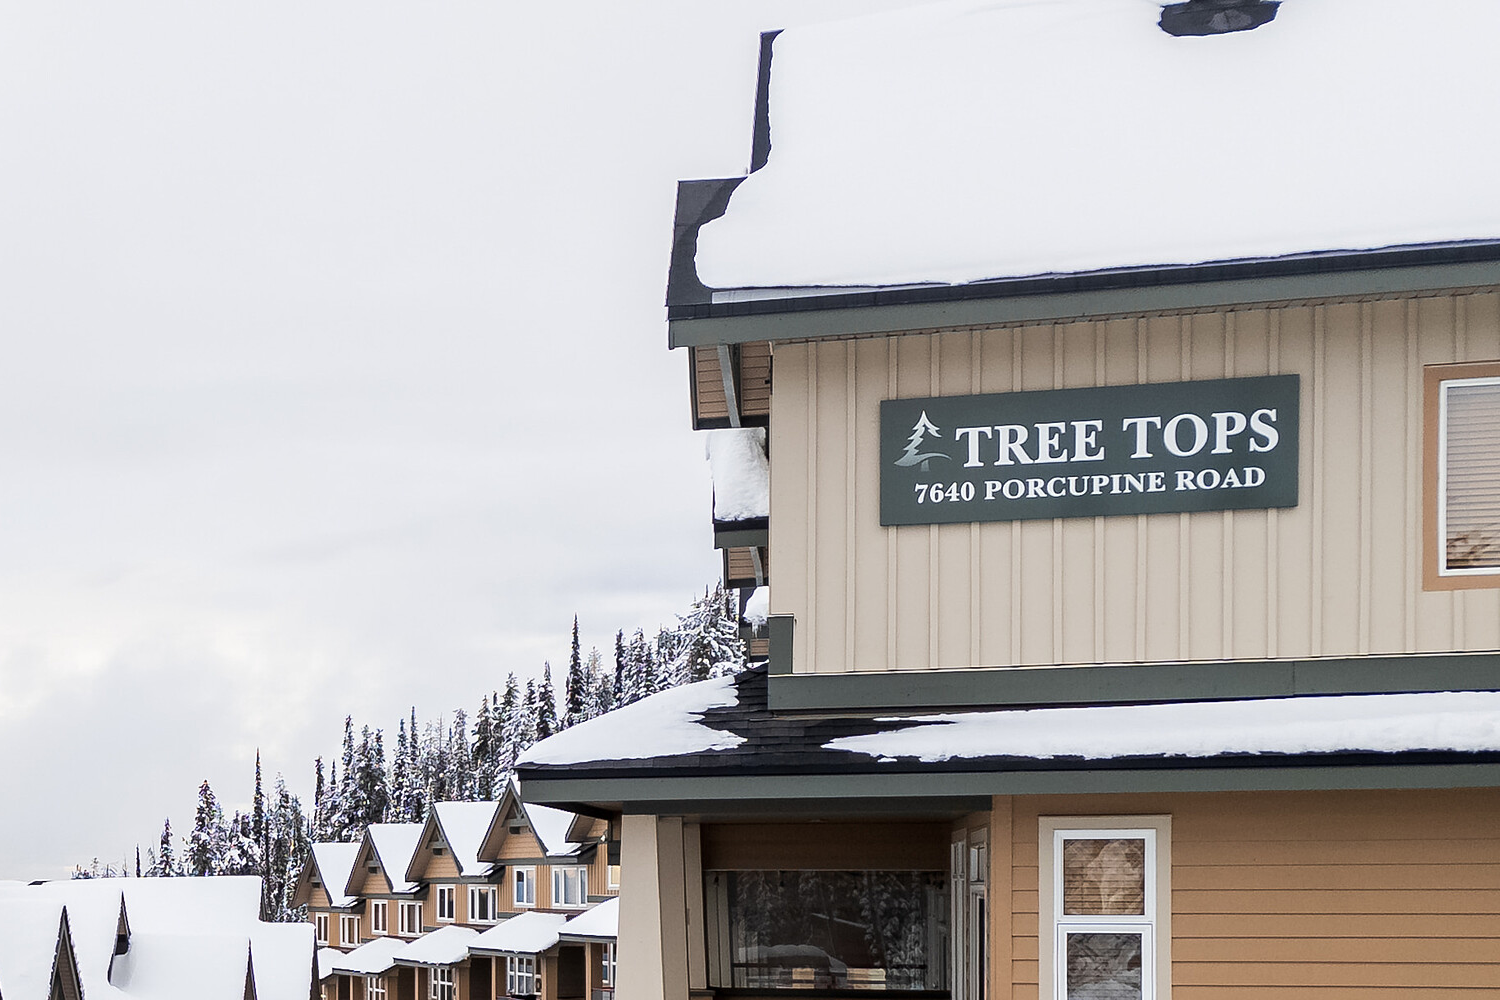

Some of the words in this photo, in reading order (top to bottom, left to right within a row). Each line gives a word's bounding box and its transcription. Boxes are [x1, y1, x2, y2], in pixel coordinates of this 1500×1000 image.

[955, 419, 1105, 468] TREE
[1122, 408, 1280, 460] TOPS
[914, 481, 975, 504] 7640
[984, 471, 1167, 501] PORCUPINE
[1175, 466, 1266, 491] ROAD
